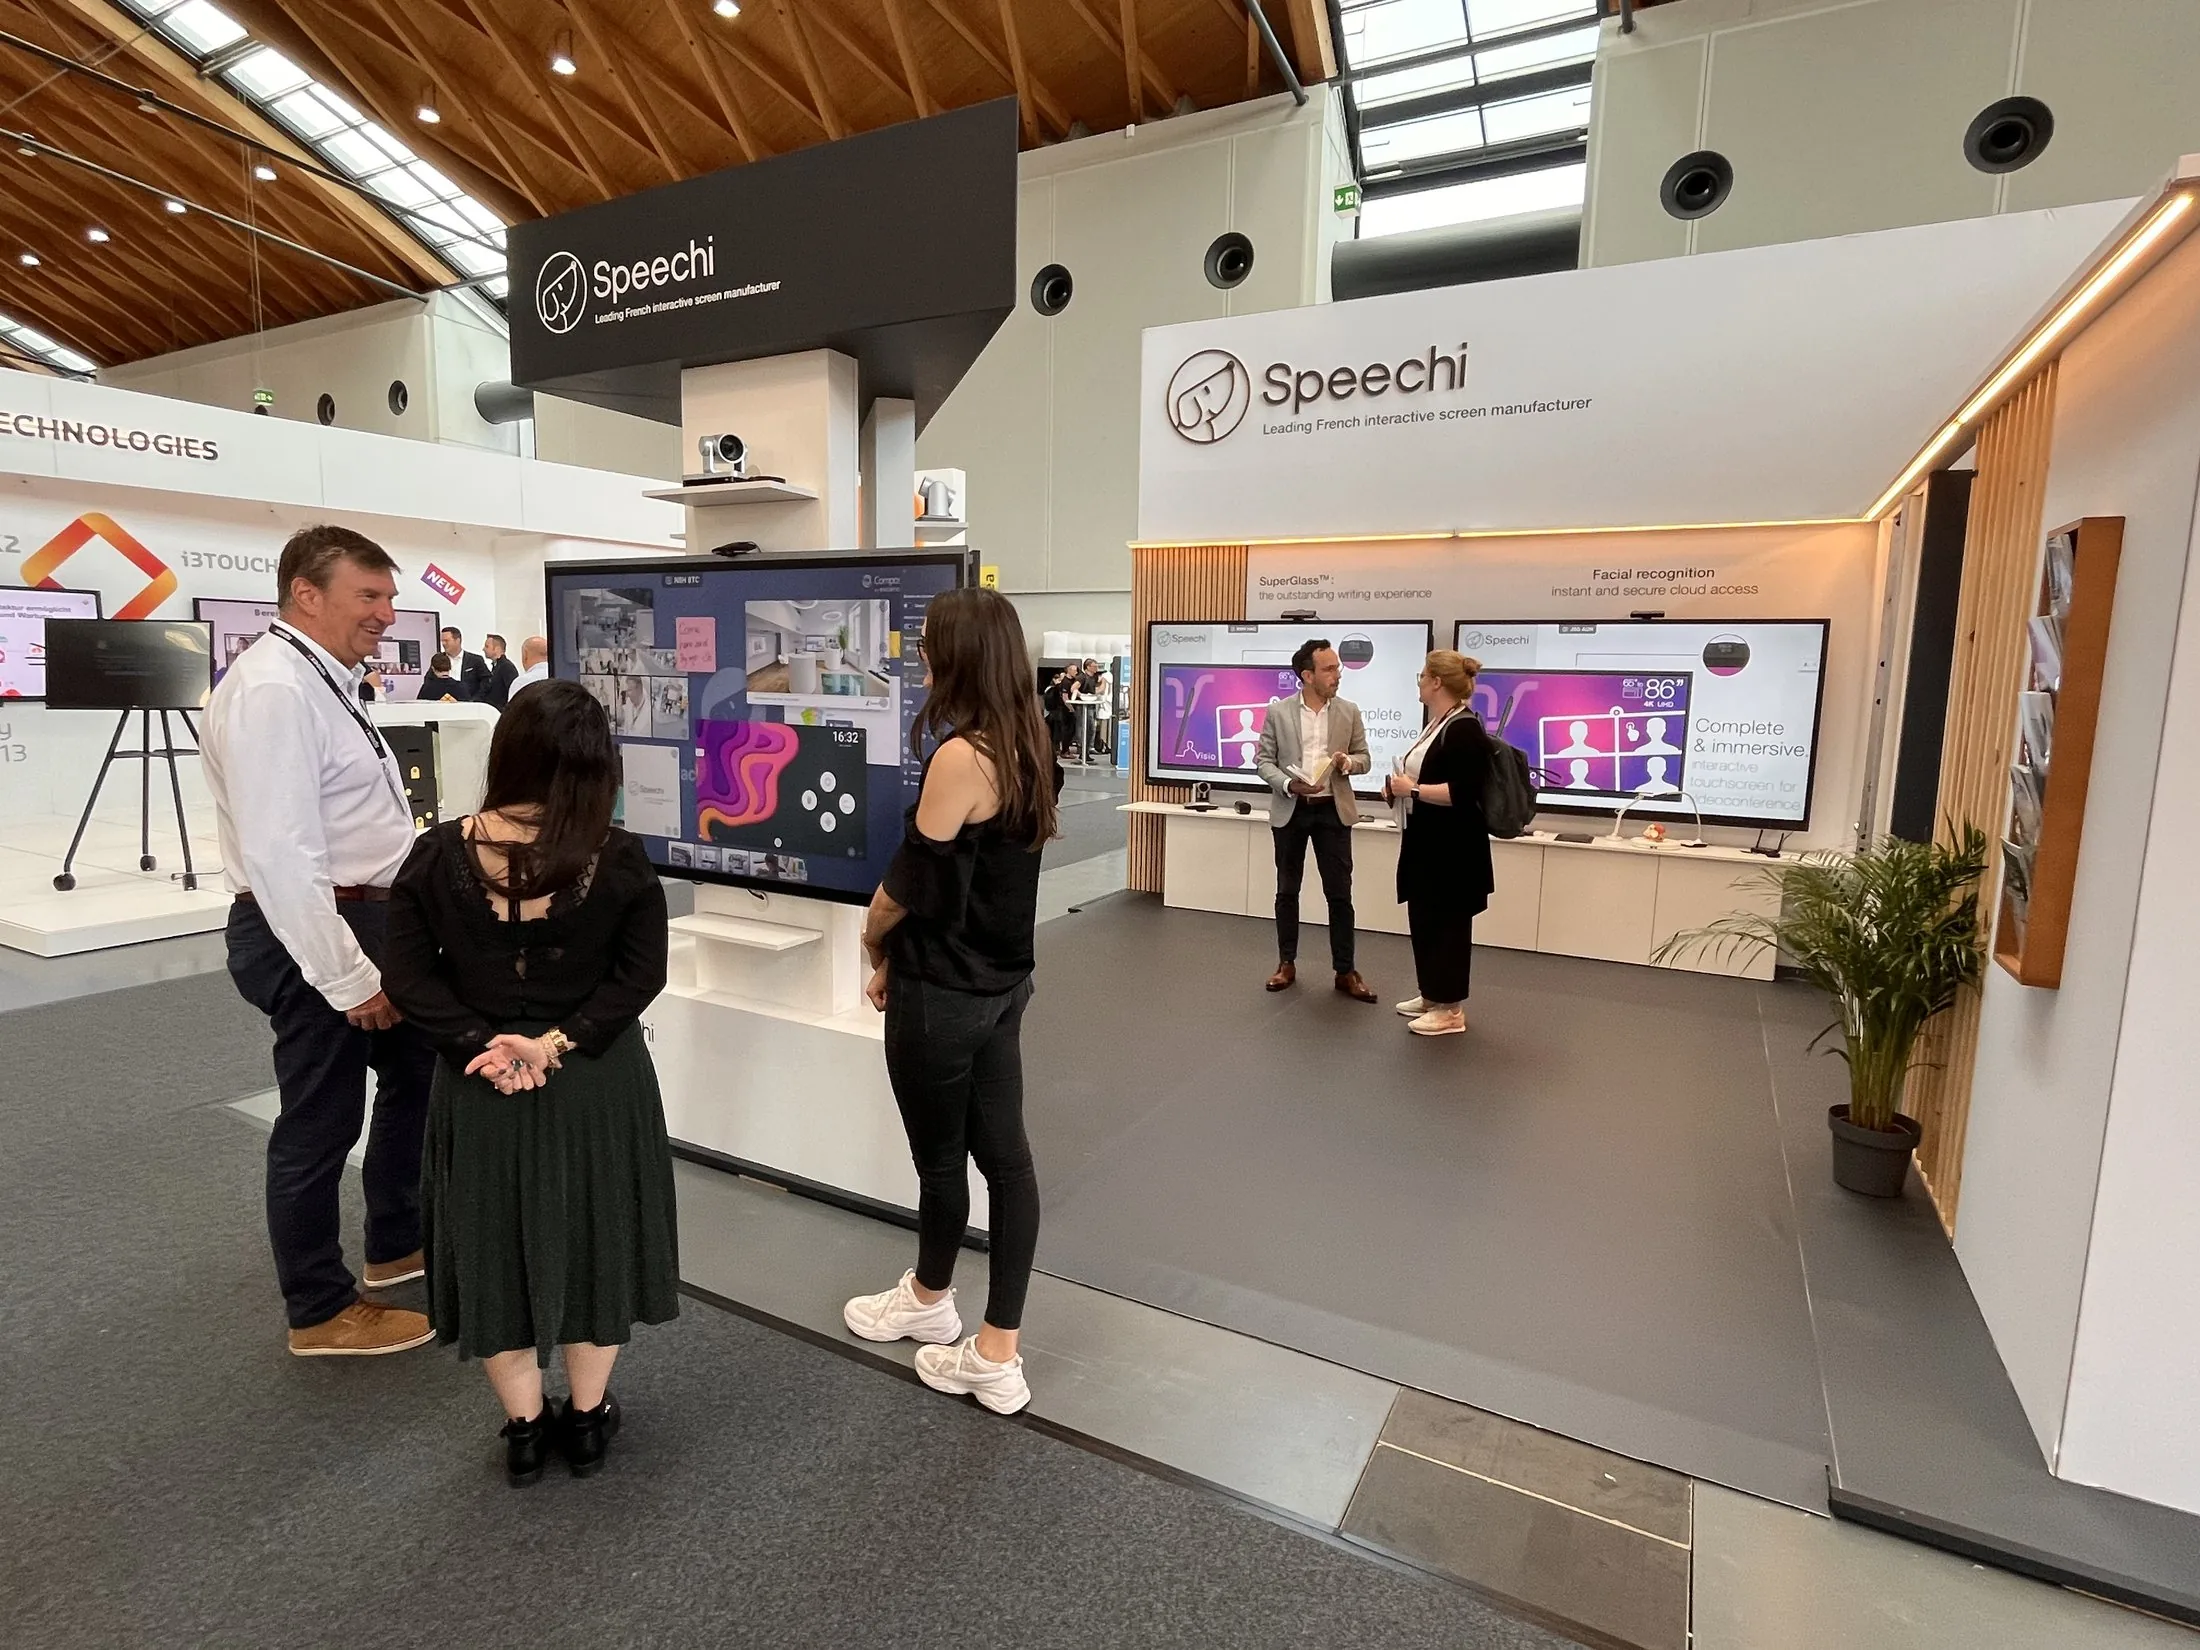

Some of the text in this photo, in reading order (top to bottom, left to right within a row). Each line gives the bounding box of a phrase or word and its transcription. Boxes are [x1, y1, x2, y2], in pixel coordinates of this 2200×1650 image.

[593, 235, 714, 304] Speechi
[595, 281, 781, 324] Leading French interactive screen manufacturer
[1262, 342, 1469, 414] Speechi
[1263, 397, 1592, 436] Leading French interactive screen manufacturer
[1593, 567, 1715, 581] Facial recognition
[427, 571, 460, 596] NEW
[1551, 584, 1759, 596] instant and secure cloud access
[1259, 589, 1432, 602] the outstanding writing experience
[1485, 634, 1529, 646] Speechi
[1696, 718, 1784, 737] Complete
[833, 731, 859, 743] 16:32
[1694, 738, 1808, 757] & immersive.
[1692, 760, 1759, 773] interactive
[1690, 776, 1797, 793] touchscreen for
